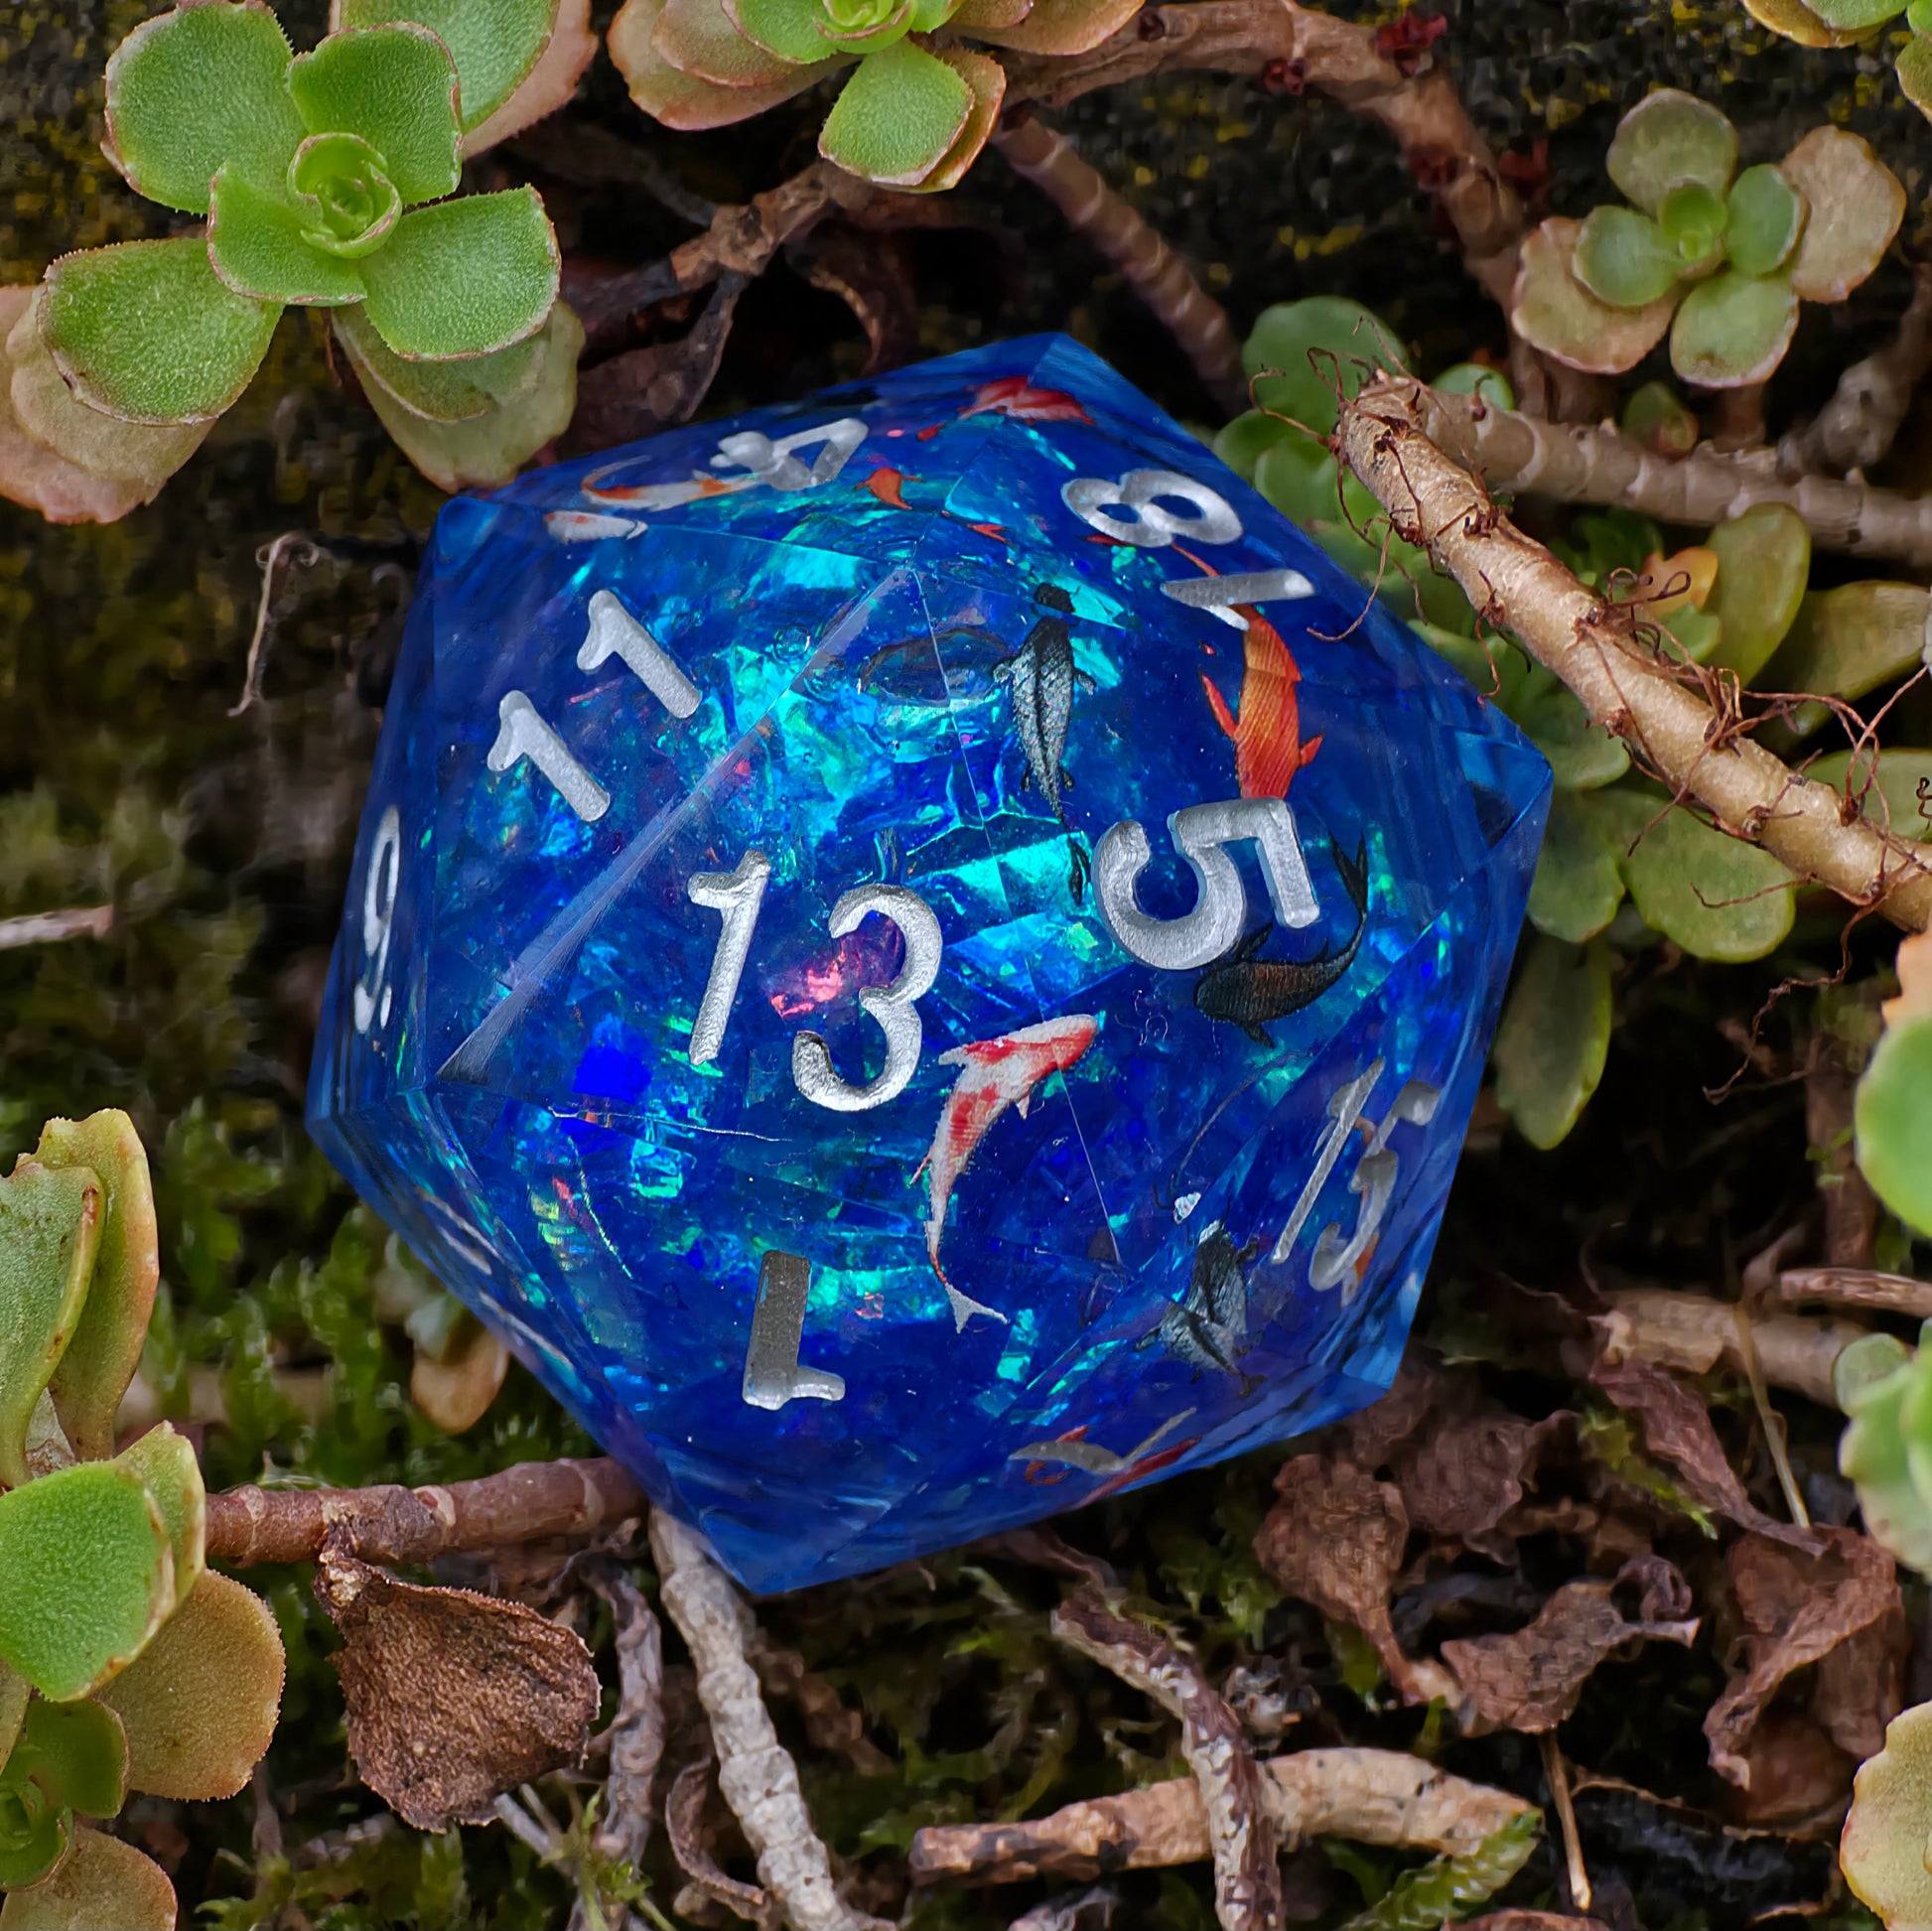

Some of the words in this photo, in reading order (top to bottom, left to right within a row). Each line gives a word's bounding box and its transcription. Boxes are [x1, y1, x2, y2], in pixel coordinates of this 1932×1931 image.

[486, 590, 703, 822] 11
[688, 850, 942, 1112] 13
[1093, 796, 1320, 970] 5
[742, 1249, 846, 1411] 1
